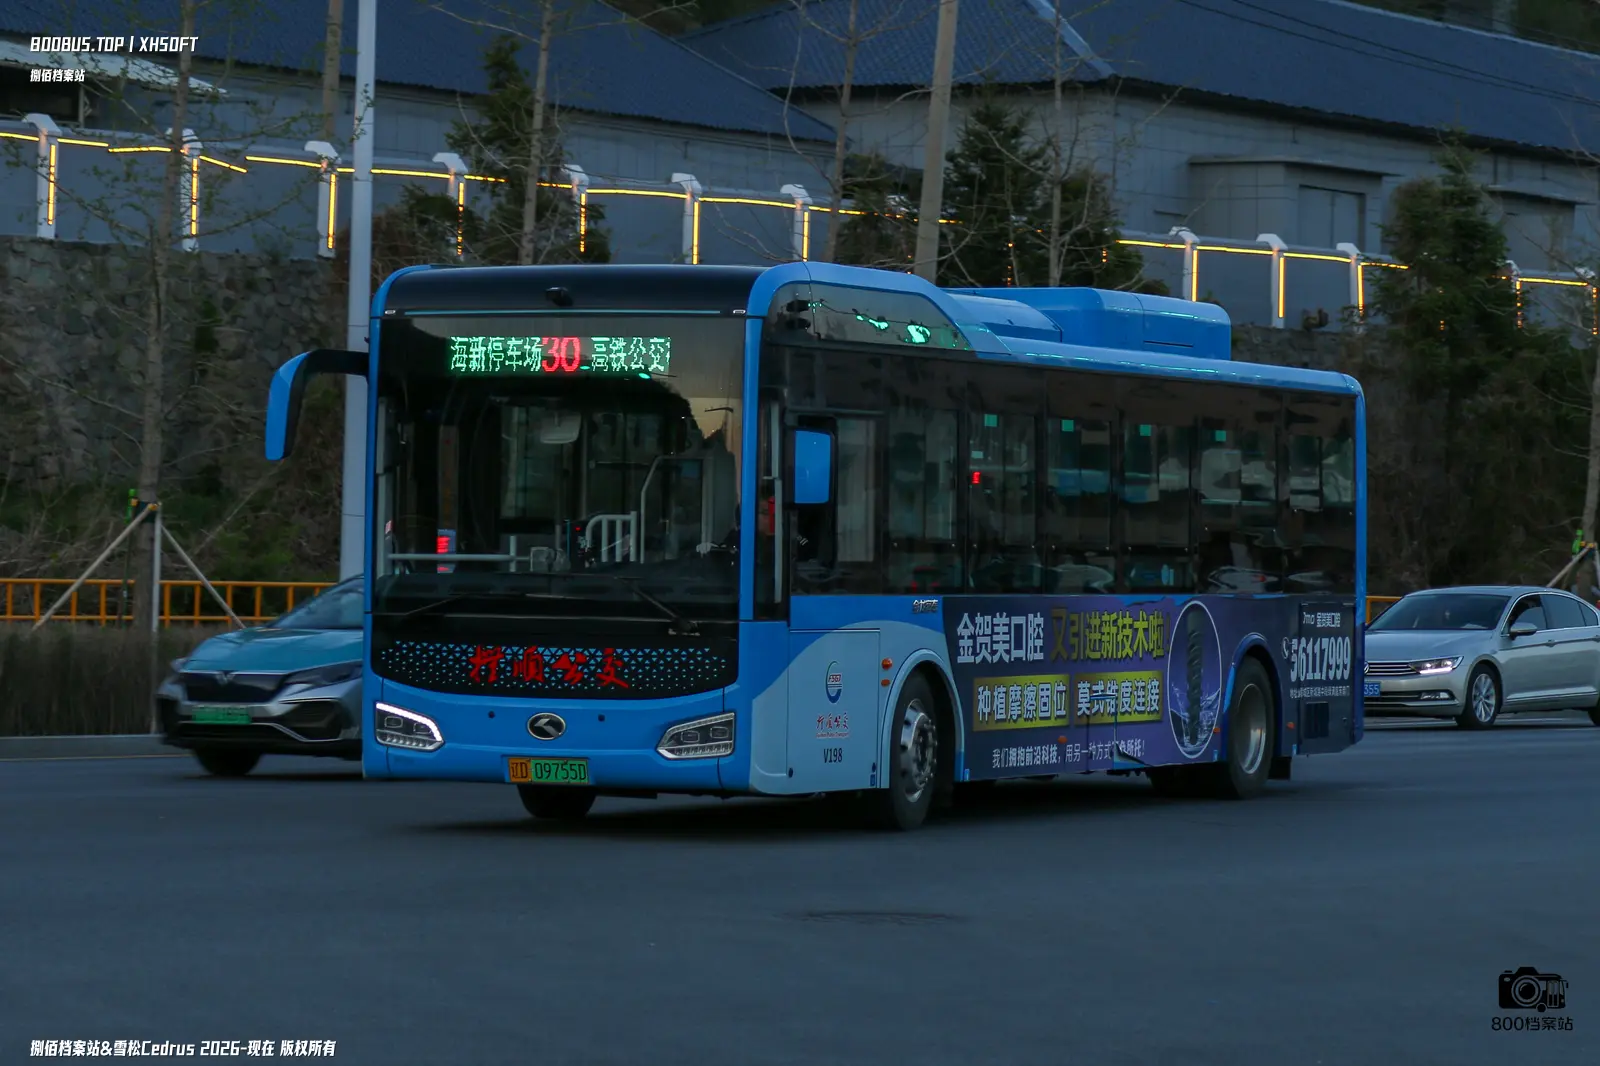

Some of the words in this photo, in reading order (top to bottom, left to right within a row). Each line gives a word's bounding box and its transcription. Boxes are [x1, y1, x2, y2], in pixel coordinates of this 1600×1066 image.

[542, 336, 580, 372] 30
[956, 612, 1044, 665] 金贺美口腔
[1291, 637, 1351, 681] 56117999
[977, 681, 1067, 723] 种植摩擦固位
[823, 748, 842, 763] V198
